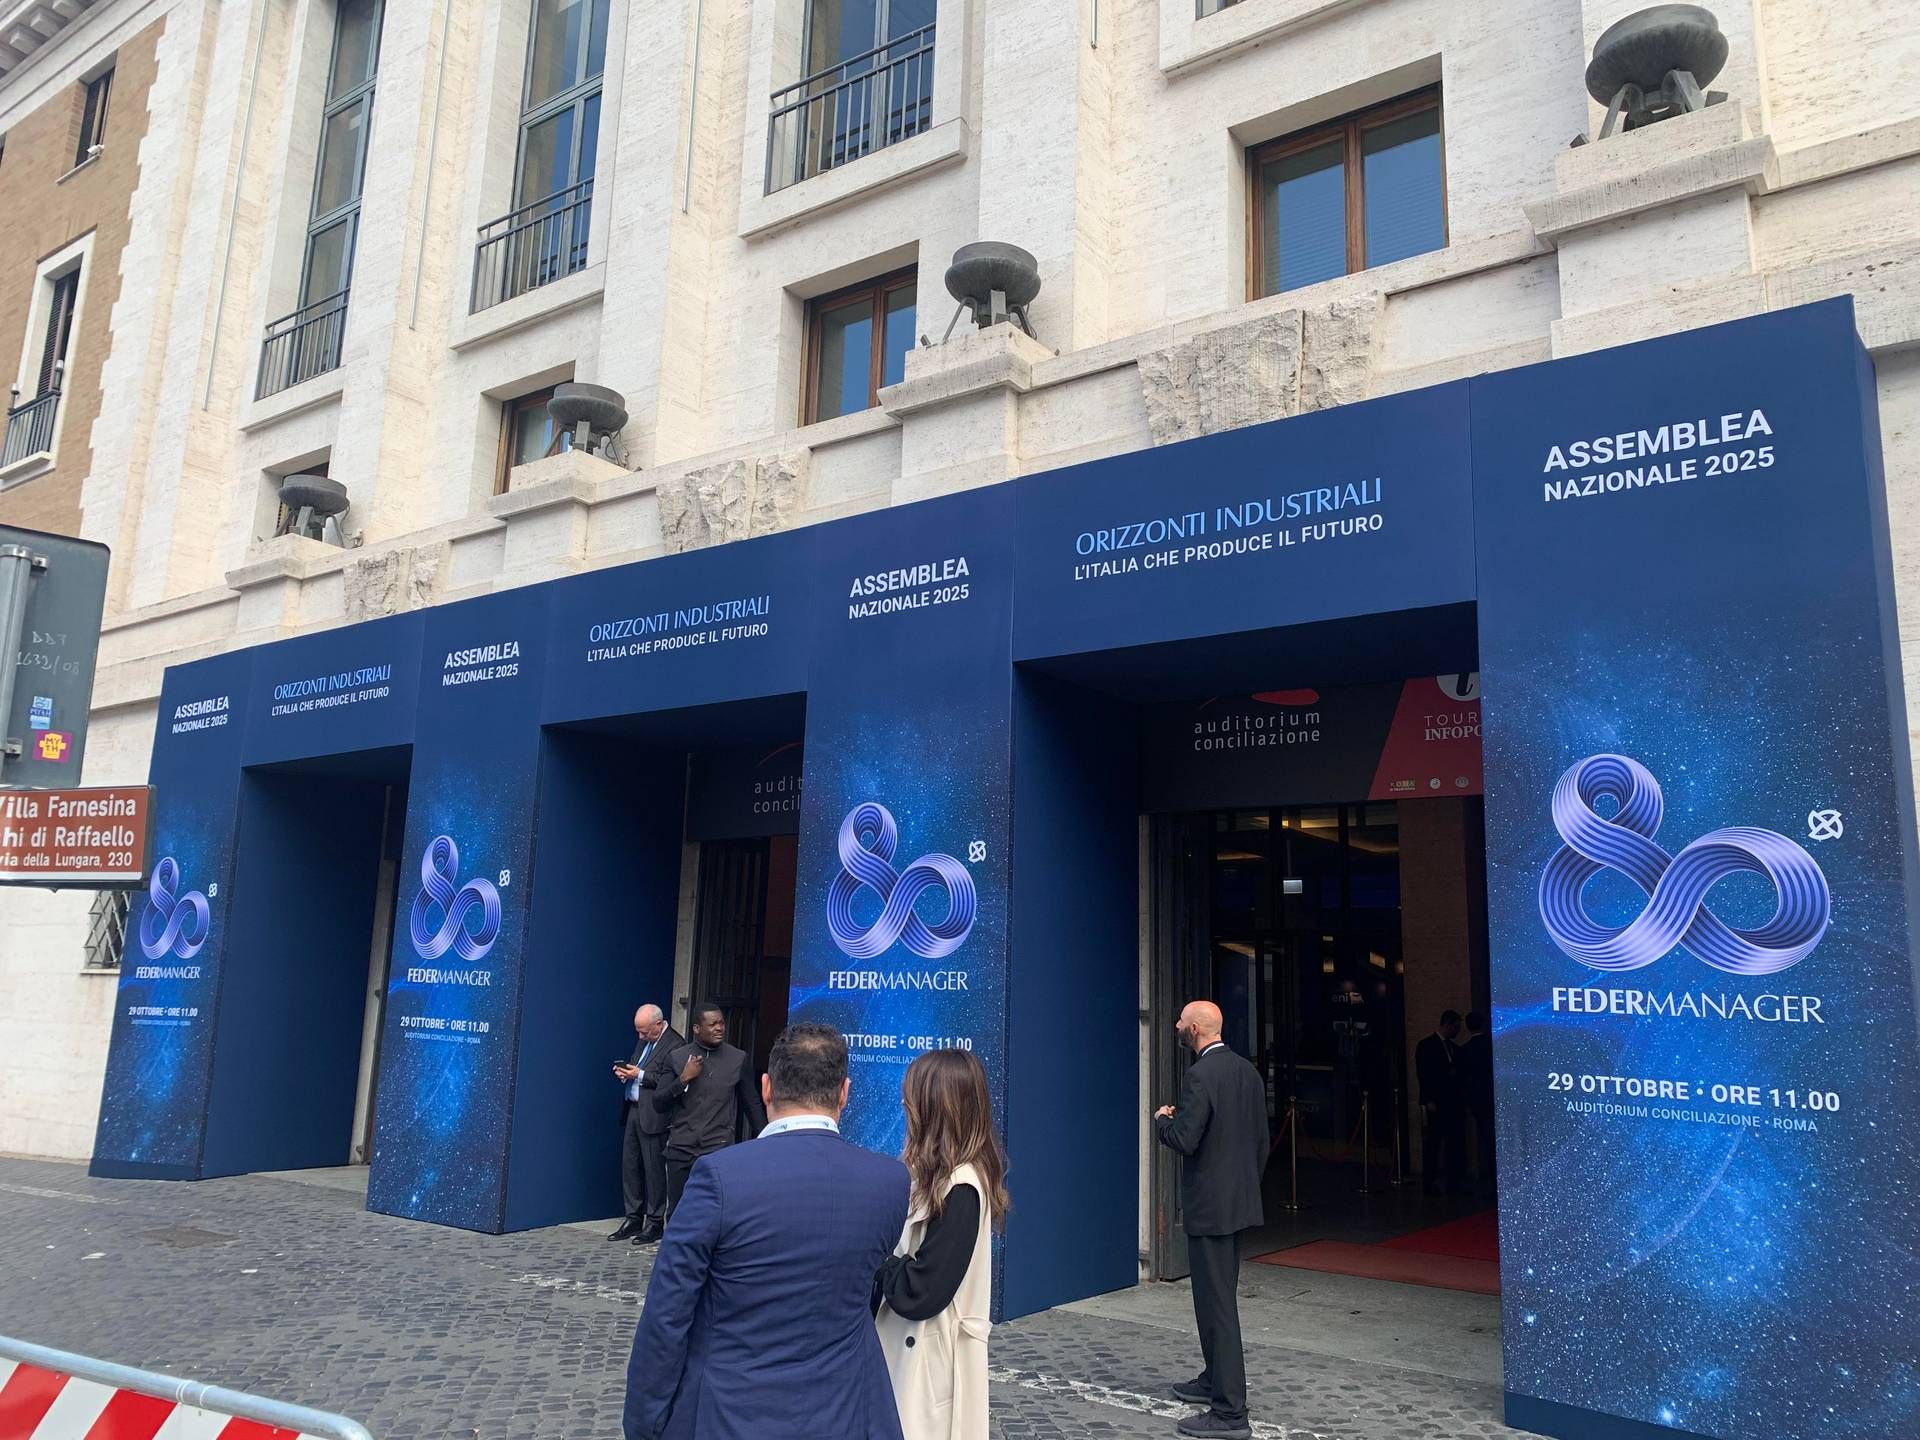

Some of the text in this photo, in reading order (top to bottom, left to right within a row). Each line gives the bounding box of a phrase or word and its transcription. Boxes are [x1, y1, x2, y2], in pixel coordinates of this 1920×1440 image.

[1543, 408, 1774, 473] ASSEMBLEA
[1544, 446, 1775, 502] NAZIONALE 2025
[1075, 477, 1382, 556] ORIZZONTI INDUSTRIALI
[1074, 513, 1384, 581] L'ITALIA CHE PRODUCE IL FUTURO
[849, 556, 970, 598] ASSEMBLEA
[848, 583, 970, 620] NAZIONALE 2025
[589, 595, 770, 643] ORIZZONTI INDUSTRIALI
[587, 622, 769, 662] L'ITALIA CHE PRODUCE IL FUTURO
[443, 640, 520, 669] ASSEMBLEA
[274, 664, 392, 700] ORIZZONTI INDUSTRIALI
[442, 663, 519, 686] NAZIONALE 2025
[174, 695, 230, 719] ASSEMBLEA
[299, 698, 315, 712] CHE
[315, 693, 350, 710] PRODUCE
[350, 692, 357, 702] IL
[358, 686, 389, 702] FUTURO
[172, 714, 228, 734] NAZIONALE 2025
[1194, 710, 1321, 734] auditorium
[1424, 711, 1478, 727] TOUR
[1194, 727, 1321, 751] conciliazione
[1424, 726, 1481, 741] INFOPO
[754, 775, 803, 794] audit
[47, 793, 137, 818] Farnesina
[753, 794, 801, 813] concil
[0, 825, 135, 848] hi di Raffaello
[23, 853, 50, 867] della
[55, 852, 103, 868] Lungara,
[107, 851, 132, 867] 230
[135, 966, 200, 979] FEDERMANAGER
[407, 967, 491, 987] FEDERMANAGER
[829, 970, 969, 991] FEDERMANAGER
[136, 1006, 164, 1016] OTTOBRE
[167, 1007, 180, 1017] ORE
[181, 1007, 198, 1017] 11.00
[1552, 986, 1825, 1023] FEDERMANAGER
[400, 1016, 489, 1033] 29 OTTOBRE ORE 11.00
[907, 1035, 933, 1050] ORE
[937, 1037, 972, 1051] 1100
[848, 1053, 918, 1065] TORIUM CONCILIAZ
[1547, 1072, 1841, 1112] 29 OTTOBRE ORE 11.00
[1566, 1100, 1818, 1132] AUDITORIUM CONCILIAZIONE ROMA
